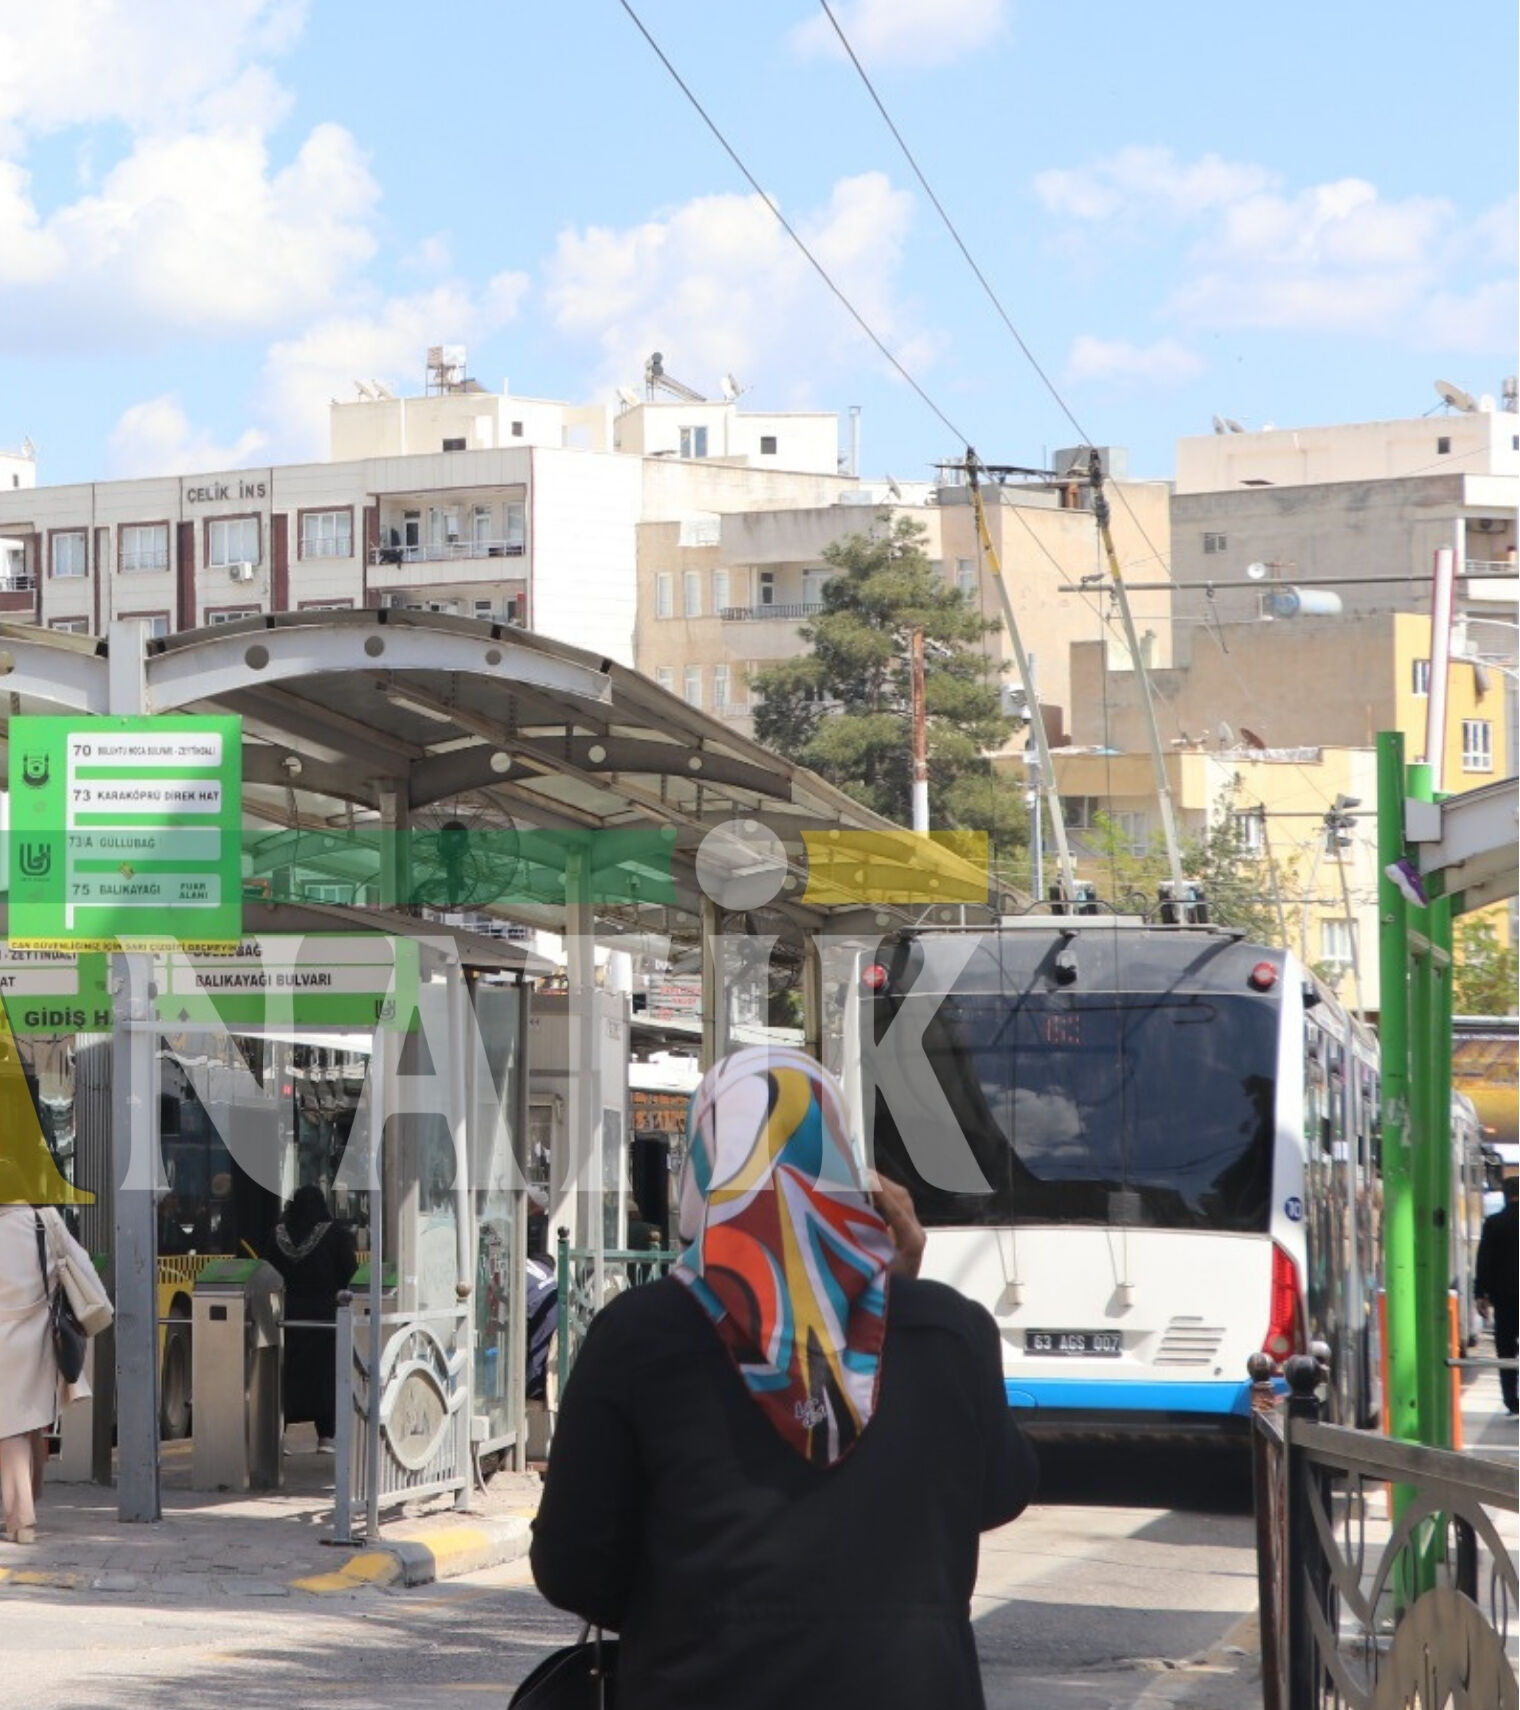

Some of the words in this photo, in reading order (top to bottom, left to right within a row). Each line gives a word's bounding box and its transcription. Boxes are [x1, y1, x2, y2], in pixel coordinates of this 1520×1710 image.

[187, 482, 229, 504] ÇELİK
[73, 744, 92, 757] 70
[73, 790, 91, 801] 73
[98, 788, 161, 801] KARAKÖPRÜ
[164, 788, 195, 801] DİREK
[199, 790, 219, 801] HAT
[72, 884, 90, 896] 75
[99, 882, 161, 896] BALIKAYAĞI
[195, 970, 271, 987] BALIKAYAĞI
[275, 972, 331, 986] BULVARI
[25, 1007, 86, 1030] GİDİŞ
[1034, 1335, 1053, 1350] 63
